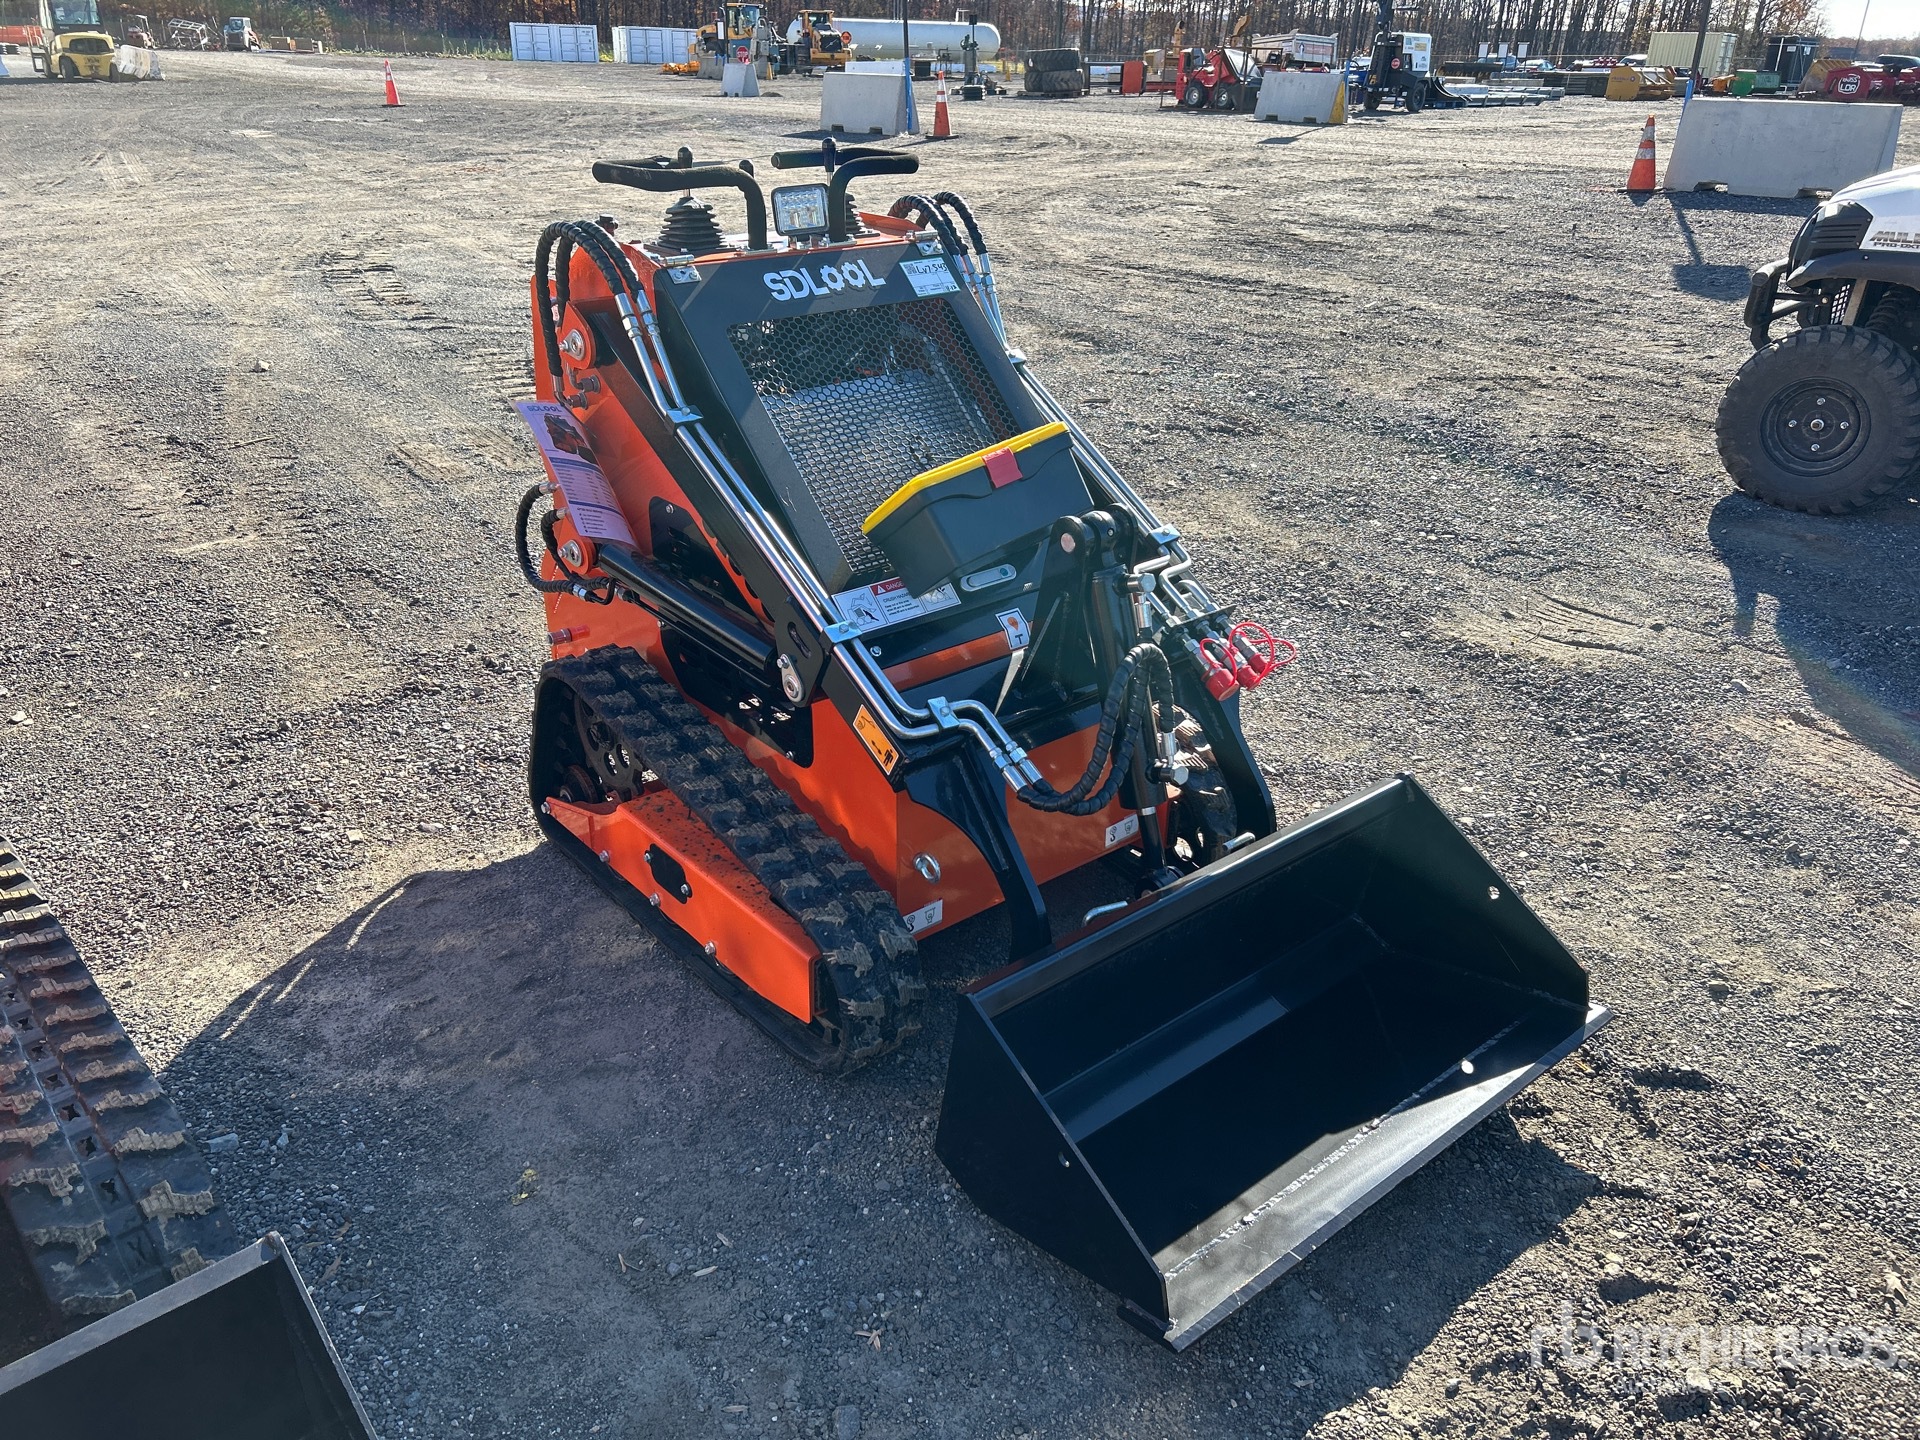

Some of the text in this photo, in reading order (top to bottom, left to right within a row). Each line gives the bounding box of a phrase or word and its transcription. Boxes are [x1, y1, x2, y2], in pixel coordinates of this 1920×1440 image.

[763, 259, 886, 301] SDLOOL
[885, 581, 905, 591] DANGE
[1015, 633, 1024, 645] T
